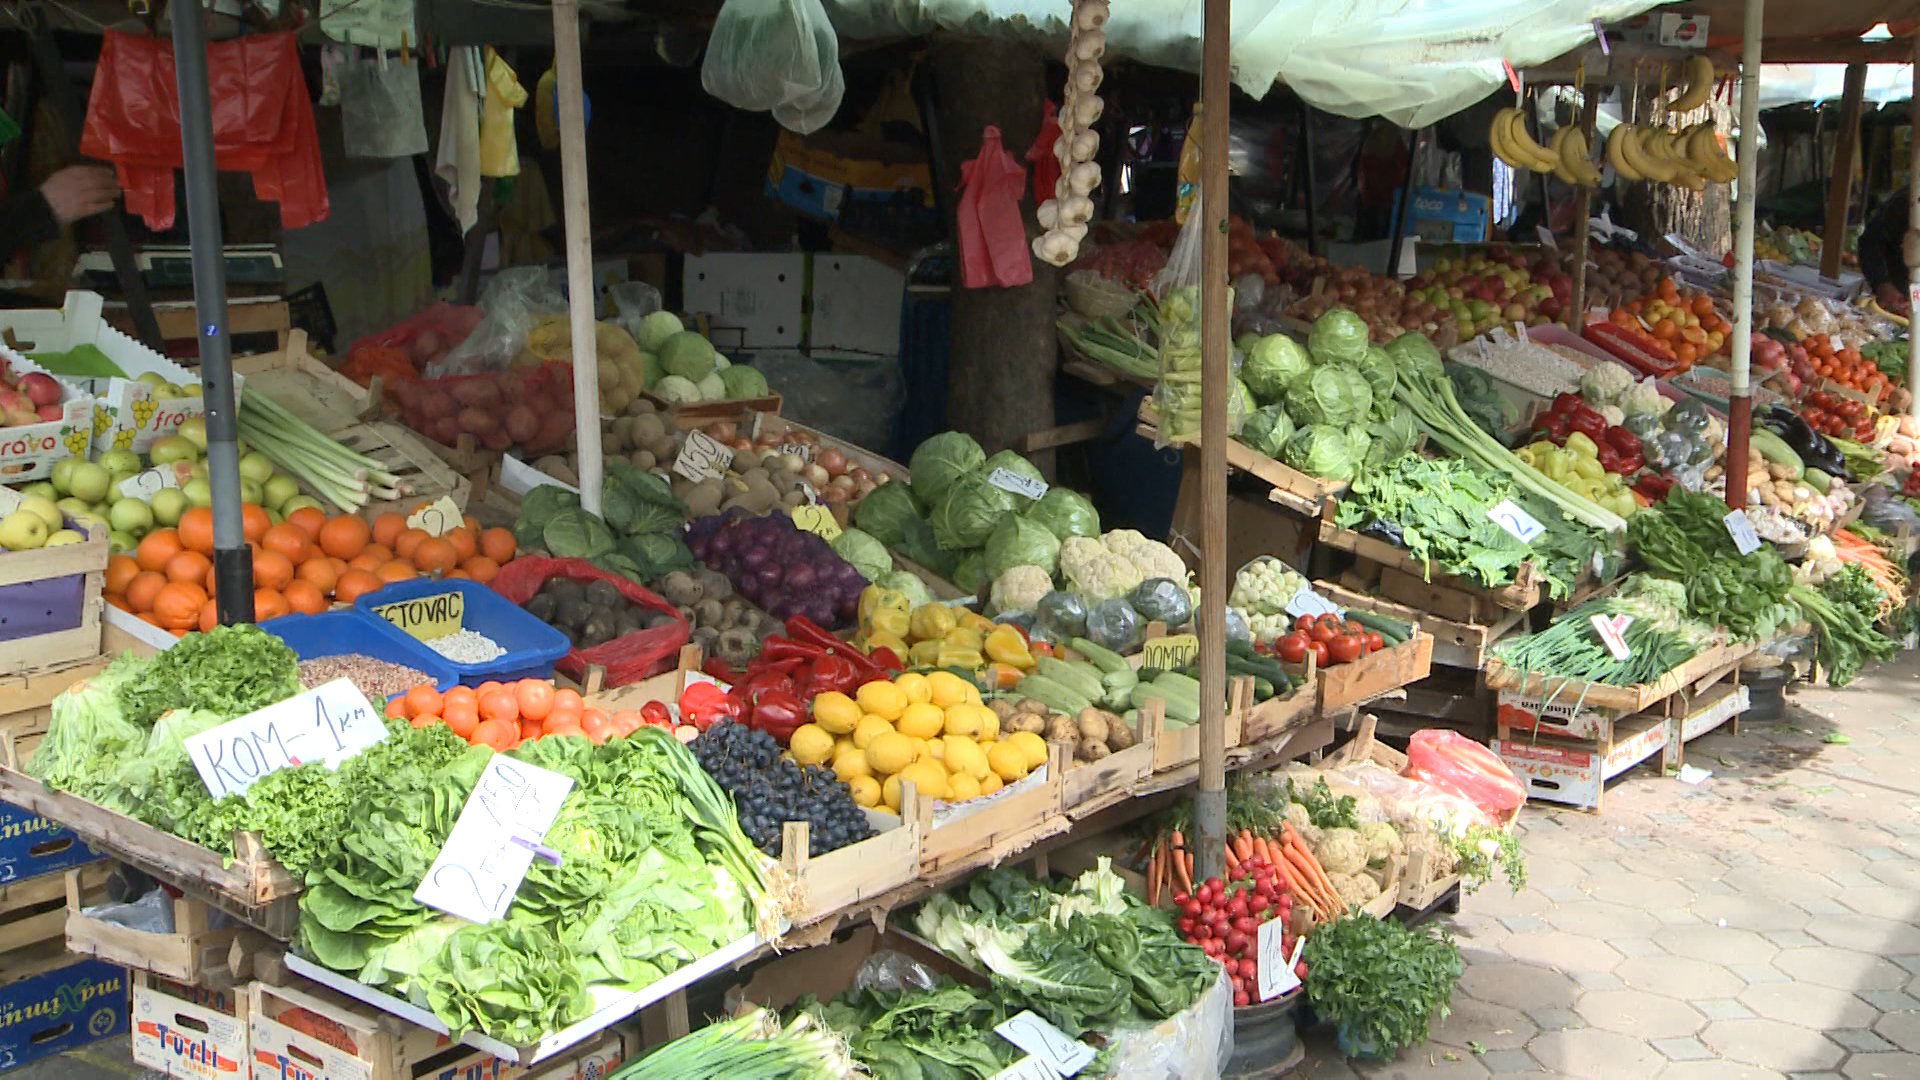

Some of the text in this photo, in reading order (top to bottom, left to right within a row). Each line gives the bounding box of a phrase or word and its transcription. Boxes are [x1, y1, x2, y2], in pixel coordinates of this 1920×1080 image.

[678, 431, 717, 479] 150
[1500, 513, 1534, 536] 2
[433, 863, 508, 913] 2
[1008, 1018, 1081, 1065] 2
